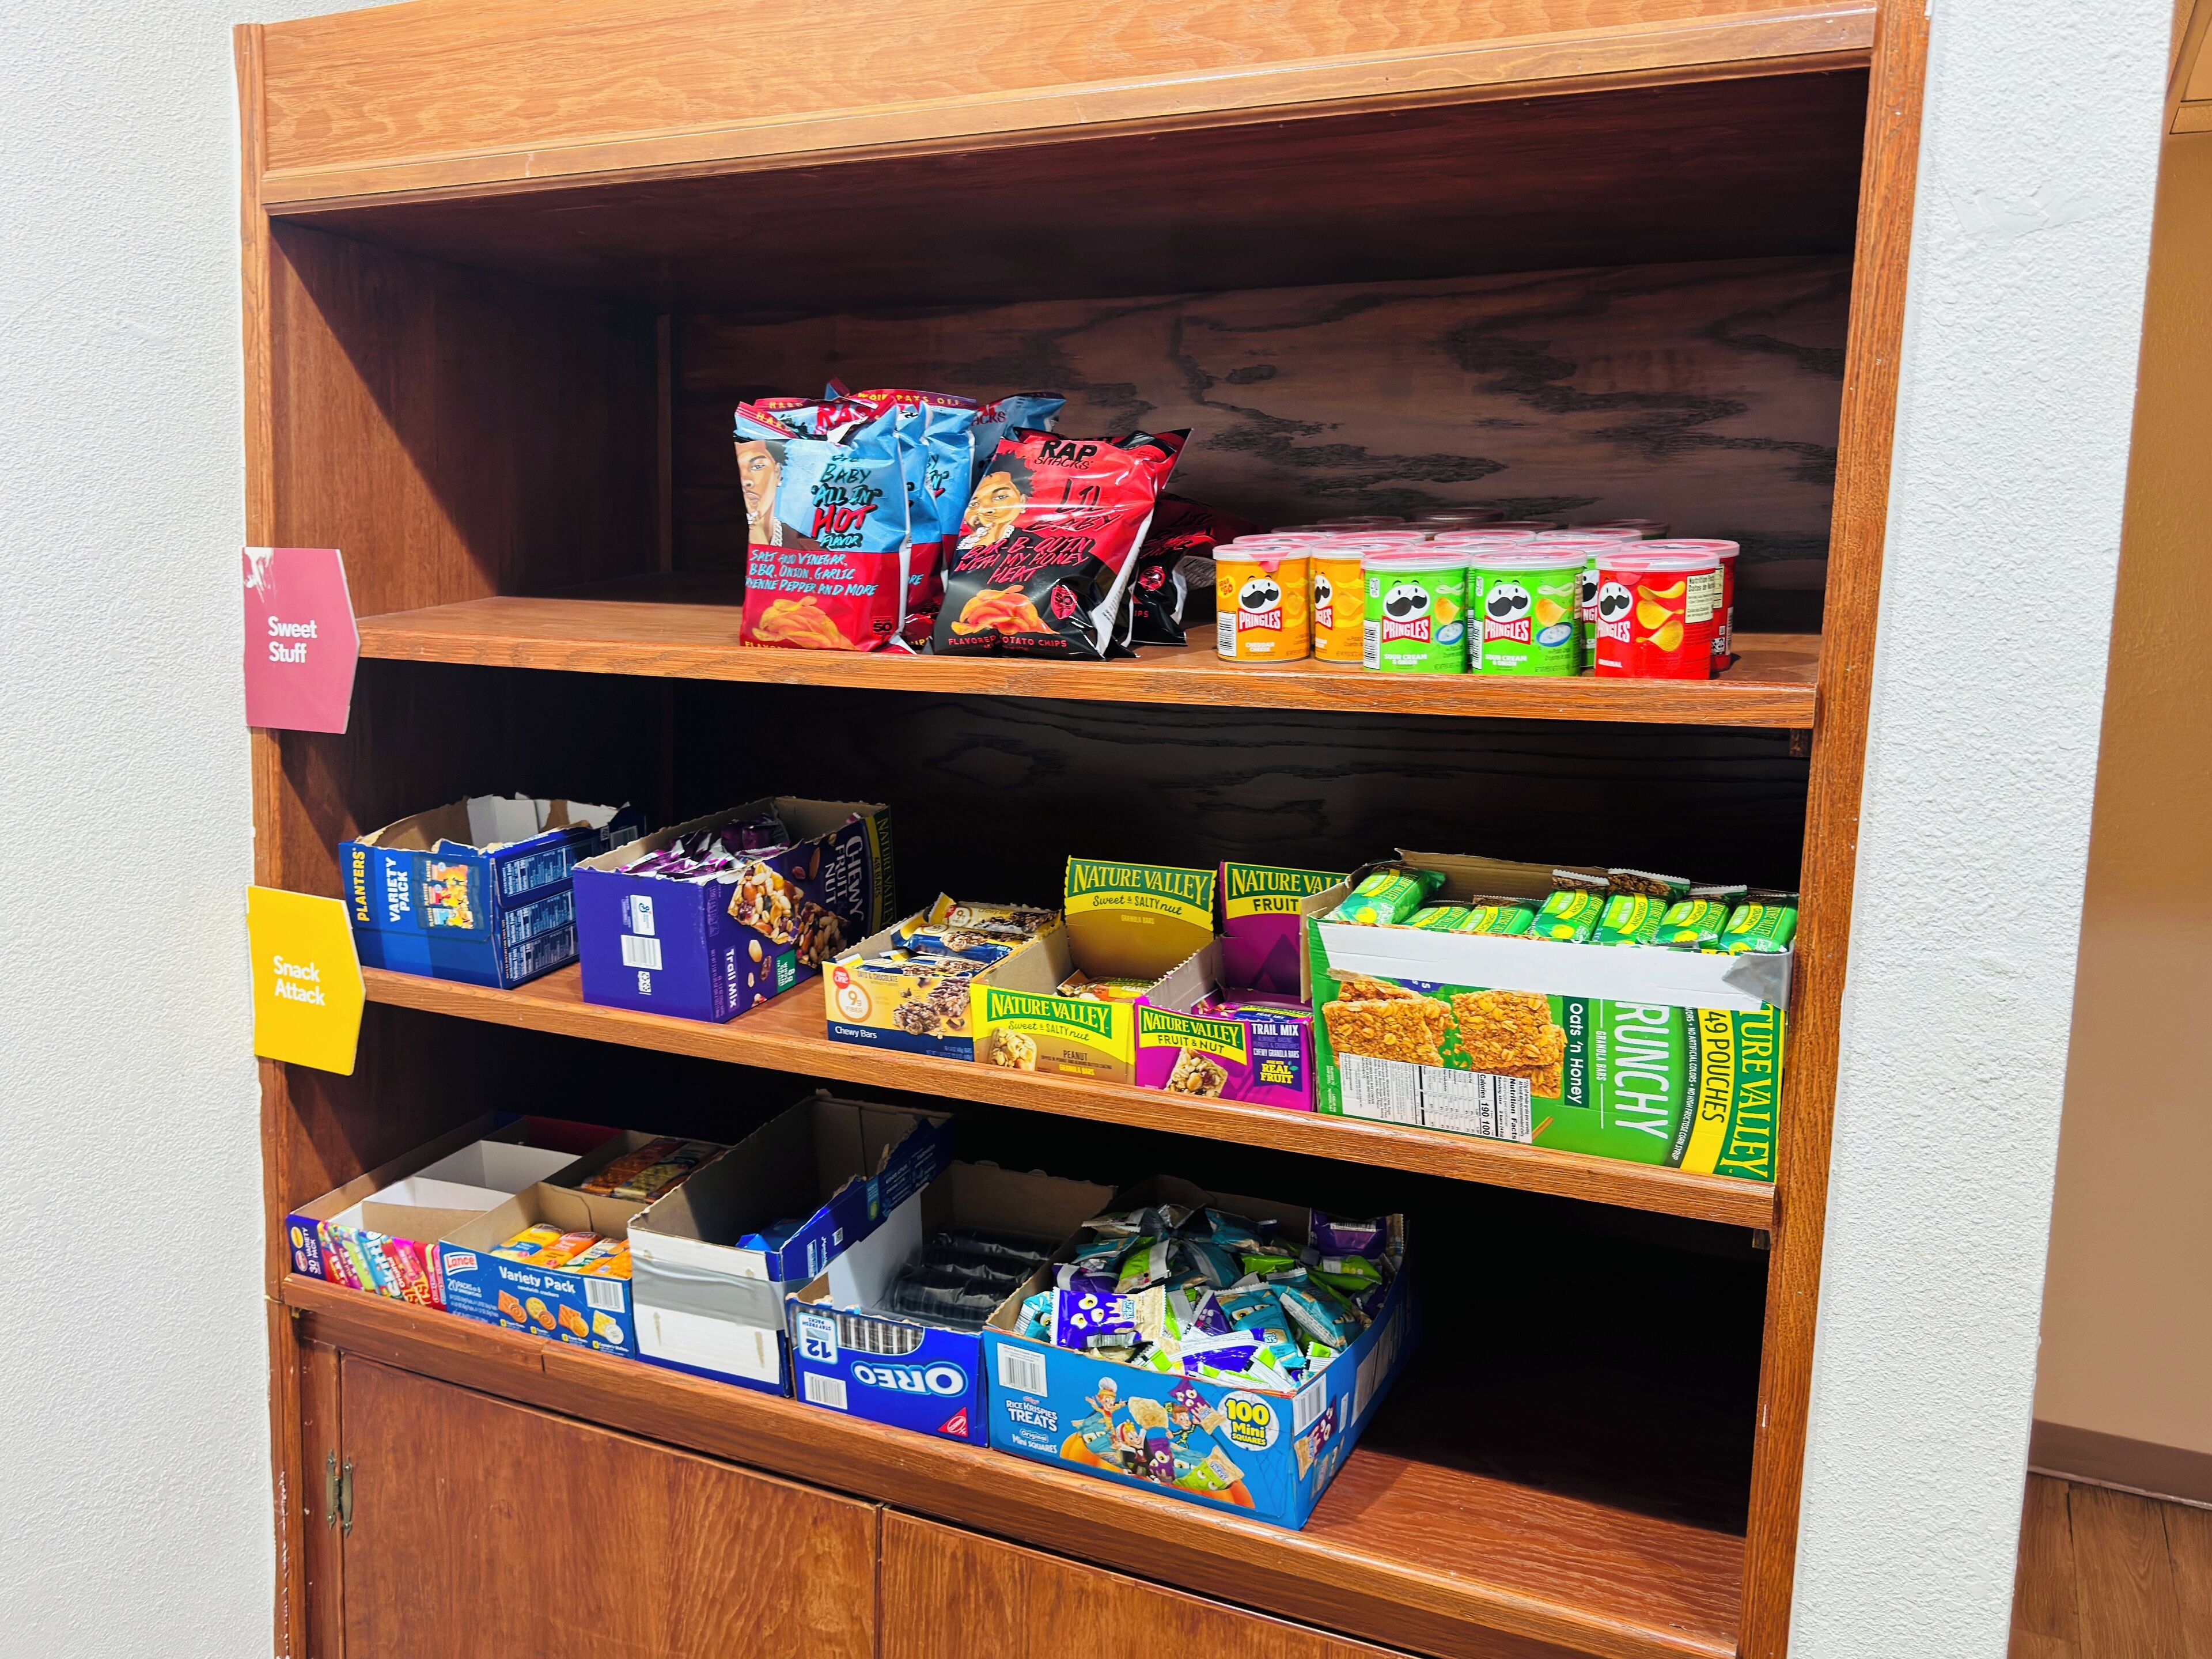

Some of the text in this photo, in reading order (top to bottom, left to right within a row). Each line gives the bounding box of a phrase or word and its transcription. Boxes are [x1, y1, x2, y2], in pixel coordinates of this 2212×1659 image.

[1039, 440, 1098, 461] RAP
[1034, 456, 1090, 469] SNACKS
[820, 463, 872, 484] BABY
[811, 503, 878, 539] HOT
[820, 535, 862, 548] FLAVOR
[750, 549, 778, 562] SALT
[954, 553, 1089, 572] WITH MY HONEY
[987, 565, 1047, 585] HEAT
[779, 579, 816, 593] PEPPER
[817, 584, 844, 596] AND
[844, 584, 880, 596] MORE
[268, 616, 317, 639] Sweet
[1239, 609, 1281, 630] PRINGLES
[1382, 619, 1429, 640] PRINGLES
[948, 634, 996, 646] FLAVORED
[1001, 636, 1035, 646] OTATO
[1037, 639, 1067, 647] CHIPS
[1484, 620, 1529, 641] PRINGLES
[268, 642, 307, 663] Stuff
[876, 817, 892, 870] NATURE
[835, 844, 847, 898] FRUIT
[845, 835, 865, 922] CHEWY
[353, 851, 370, 922] PLANTERS
[385, 857, 401, 922] VARIETY
[397, 871, 410, 911] PACK
[825, 862, 837, 904] NUT
[1073, 864, 1209, 906] NATURE VALLEY
[1231, 868, 1302, 896] NATURE
[1377, 876, 1397, 891] CRUNCHY
[1093, 894, 1183, 916] Sweet & SALTY nut
[1253, 898, 1300, 912] FRUIT
[1569, 896, 1586, 914] CRUNCHY
[1630, 902, 1646, 926] CRUNCHY
[1688, 904, 1706, 921] CRUNCHY
[1121, 915, 1154, 925] GRANOLA BARS
[1477, 913, 1497, 931] CRUNCHY
[1635, 899, 1666, 937] NATURE VALLEY
[1746, 908, 1763, 926] CRUNCHY
[273, 955, 320, 982] Snack
[726, 949, 737, 1008] Trail Mix
[787, 968, 795, 983] 8g
[834, 976, 849, 984] One
[275, 978, 325, 1006] Attack
[846, 1005, 863, 1013] FIBER
[991, 993, 1109, 1033] NATURE VALLEY
[835, 1026, 877, 1039] Chewy Bars
[1008, 1020, 1037, 1031] Sweet
[1046, 1023, 1069, 1036] SALTY
[1070, 1031, 1090, 1041] nut
[1143, 1011, 1239, 1047] NATURE VALLEY
[1251, 1024, 1299, 1036] TRAIL MIX
[1688, 1027, 1696, 1035] NO
[1158, 1035, 1188, 1046] FRUIT
[1199, 1040, 1225, 1054] NUT
[1253, 1048, 1299, 1059] CHEWY GRANOLA BARS
[1566, 1002, 1584, 1105] Oats 'n Honey
[1688, 1036, 1697, 1063] ARTIFICIAL
[1063, 1050, 1088, 1062] PEANUT
[1595, 1031, 1607, 1082] GRANOLA BARS
[1059, 1063, 1095, 1076] GRANOLA BARS
[1262, 1063, 1291, 1075] REAL
[1615, 1001, 1670, 1139] RUNCHY
[1688, 1063, 1697, 1083] COLORS
[1702, 1010, 1731, 1123] 49 POUCHES
[1260, 1071, 1293, 1084] FRUIT
[1687, 1087, 1696, 1095] NO
[1719, 1003, 1774, 1178] TURE VALLEY
[1481, 1103, 1490, 1118] 190
[1685, 1095, 1695, 1108] HIGH
[1482, 1121, 1490, 1135] 100
[1680, 1108, 1693, 1132] FRUCTOSE
[1676, 1131, 1688, 1146] CORN
[1671, 1145, 1683, 1160] SYRUP
[303, 1228, 313, 1257] VARIETY
[308, 1239, 319, 1273] 30 PACK
[445, 1256, 476, 1268] Lance
[447, 1278, 459, 1291] 20
[498, 1266, 541, 1288] Variety
[544, 1277, 577, 1294] Pack
[517, 1285, 539, 1293] sandwich
[802, 1321, 819, 1330] FRESH
[806, 1338, 832, 1359] 12
[854, 1365, 965, 1395] OREO
[1006, 1400, 1058, 1421] RICE KRISPIES
[1008, 1408, 1058, 1431] TREATS
[1226, 1399, 1271, 1425] 100
[1021, 1430, 1047, 1441] Original
[1232, 1422, 1265, 1438] Mini
[1232, 1433, 1267, 1446] SQUARES
[1012, 1434, 1058, 1454] Mini SQUARES
